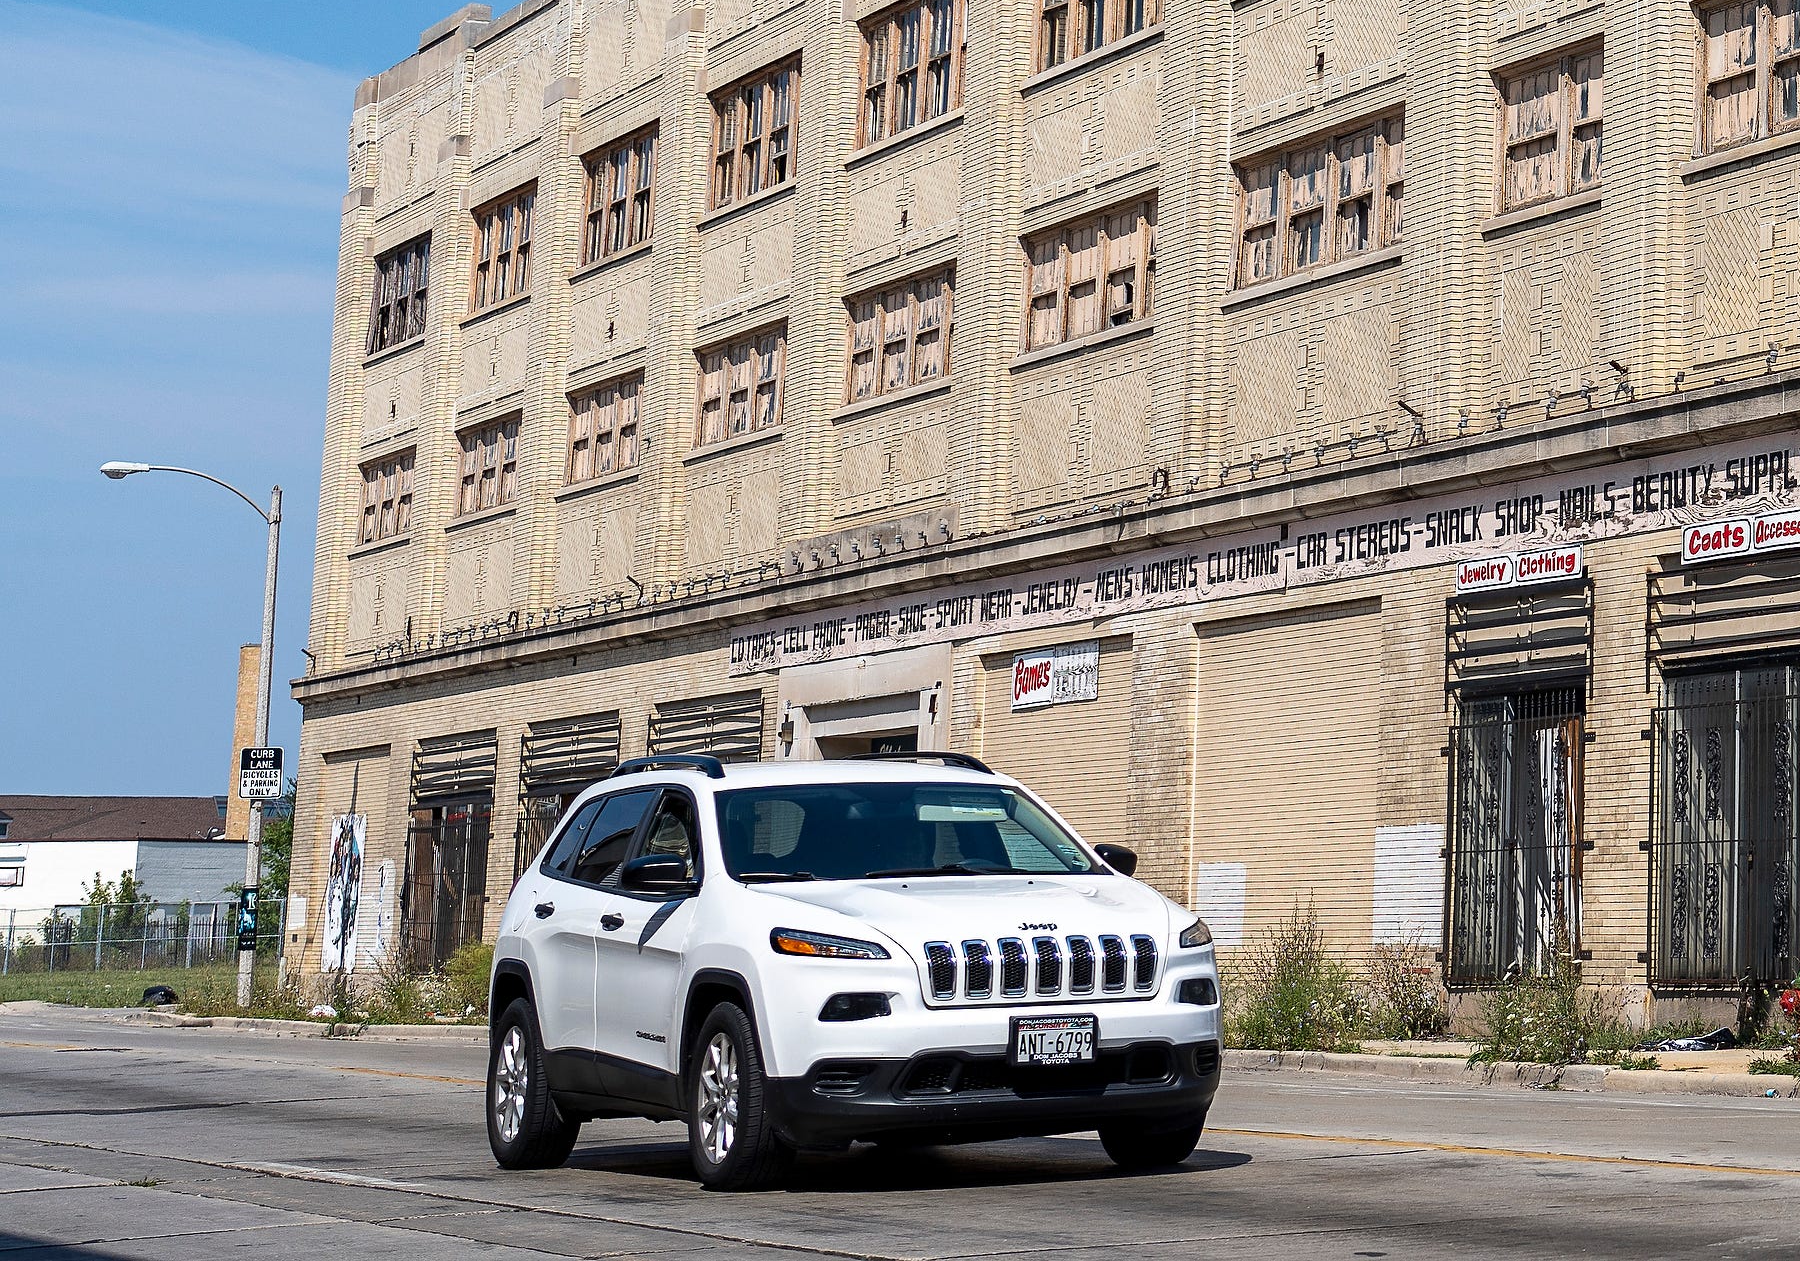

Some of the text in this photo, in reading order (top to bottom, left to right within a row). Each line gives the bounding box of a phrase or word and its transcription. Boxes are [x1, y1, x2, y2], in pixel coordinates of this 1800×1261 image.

[1207, 540, 1280, 585] CLOTHING
[1296, 531, 1328, 570] CAR
[1335, 516, 1411, 563] STEREOS
[1425, 504, 1483, 549] SNACK
[1495, 494, 1544, 537] SHOP
[1632, 463, 1715, 515] BEAUTY
[1689, 524, 1744, 555] Coats
[1460, 551, 1576, 585] Jewelry Clothing
[1014, 658, 1051, 700] Games
[250, 749, 275, 758] CURB
[250, 760, 274, 768] LANE
[1019, 1032, 1093, 1055] ANT-6799
